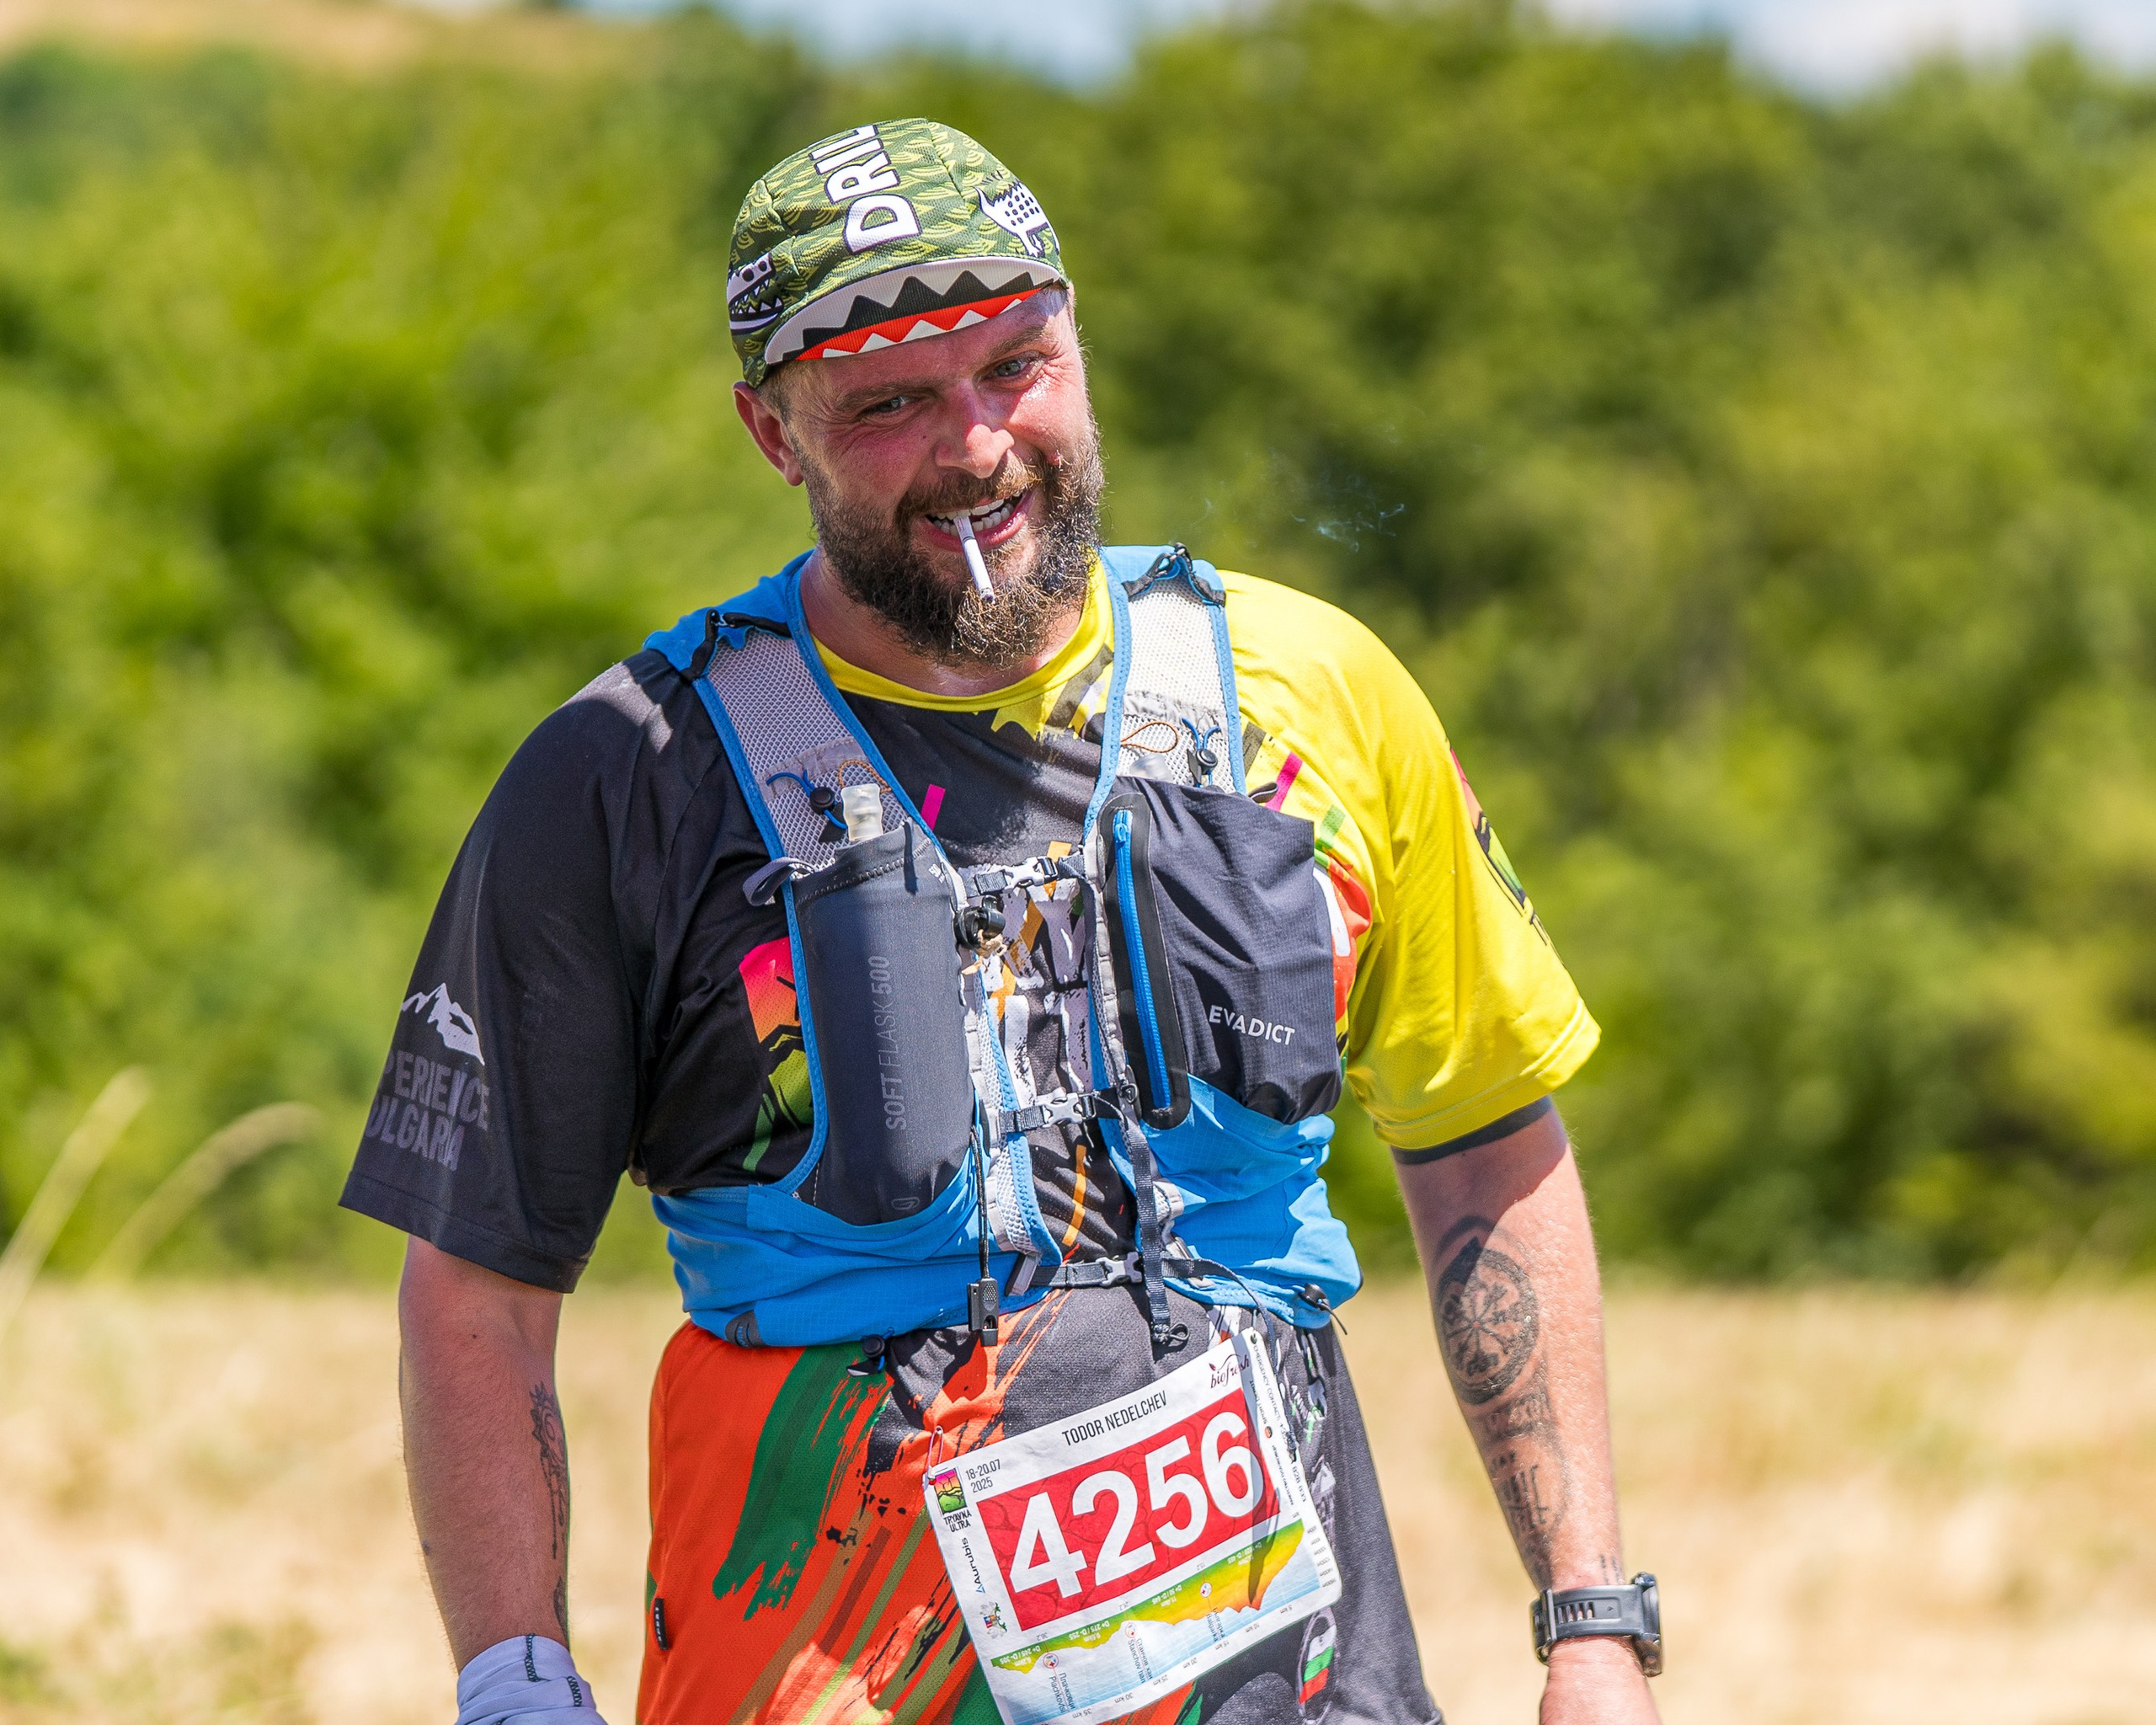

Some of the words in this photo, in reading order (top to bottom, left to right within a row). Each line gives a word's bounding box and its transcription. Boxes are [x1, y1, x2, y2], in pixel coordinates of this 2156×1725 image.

[871, 955, 892, 996] 500
[875, 1003, 900, 1070] FLASK
[1209, 1005, 1295, 1045] EVADICT
[878, 1072, 907, 1130] SOFT
[1210, 1354, 1250, 1388] biofresh
[1253, 1344, 1270, 1386] EMERGENCY
[1062, 1420, 1106, 1446] TODOR
[1104, 1390, 1168, 1435] NEDELCHEV
[965, 1459, 1001, 1481] 18-20.07
[971, 1477, 994, 1493] 2025
[943, 1509, 972, 1525] TRYAVNA
[950, 1519, 971, 1532] ULTRA
[1009, 1412, 1263, 1599] 4256
[961, 1537, 981, 1584] Aurubis
[1128, 1640, 1140, 1669] Stanchov
[1059, 1673, 1075, 1709] Плачковци
